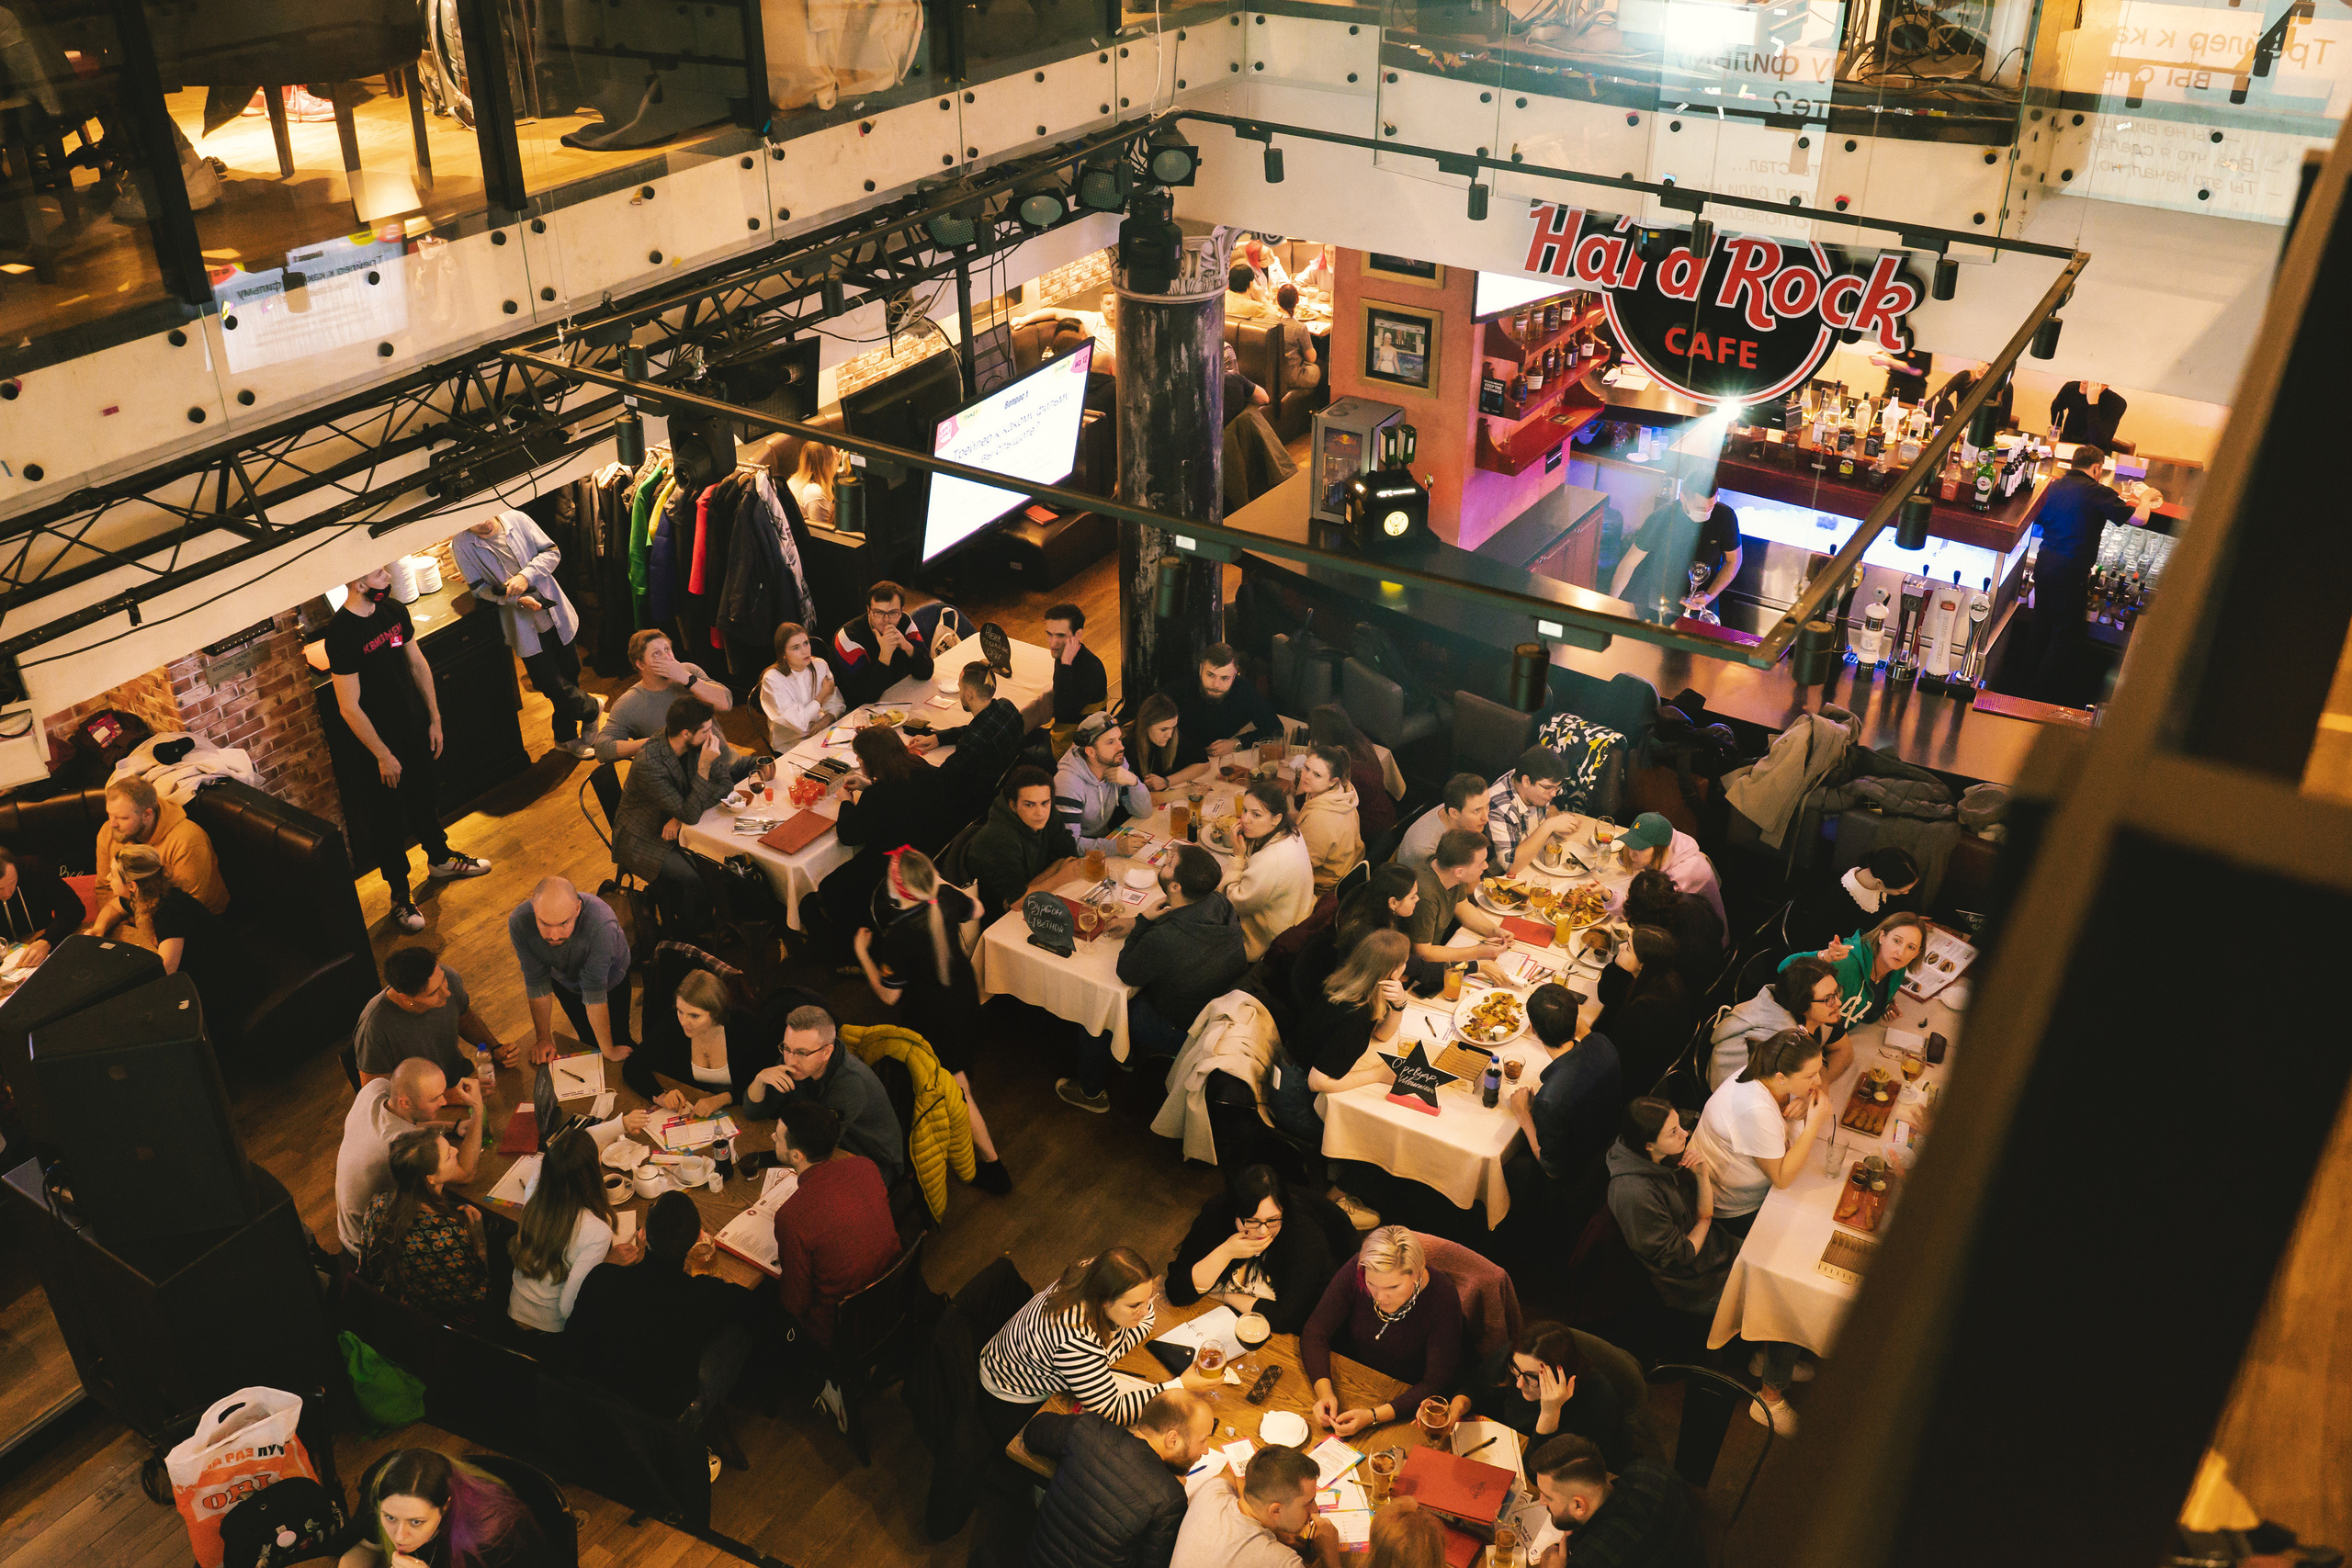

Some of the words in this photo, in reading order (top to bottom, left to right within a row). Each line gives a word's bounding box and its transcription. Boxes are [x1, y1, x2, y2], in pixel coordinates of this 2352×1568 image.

[1524, 199, 1716, 299] Hard
[1716, 233, 1916, 353] Rock
[1665, 327, 1758, 368] CAFE
[363, 622, 402, 654] КВИЗМЕН
[225, 1447, 254, 1463] РАЗ
